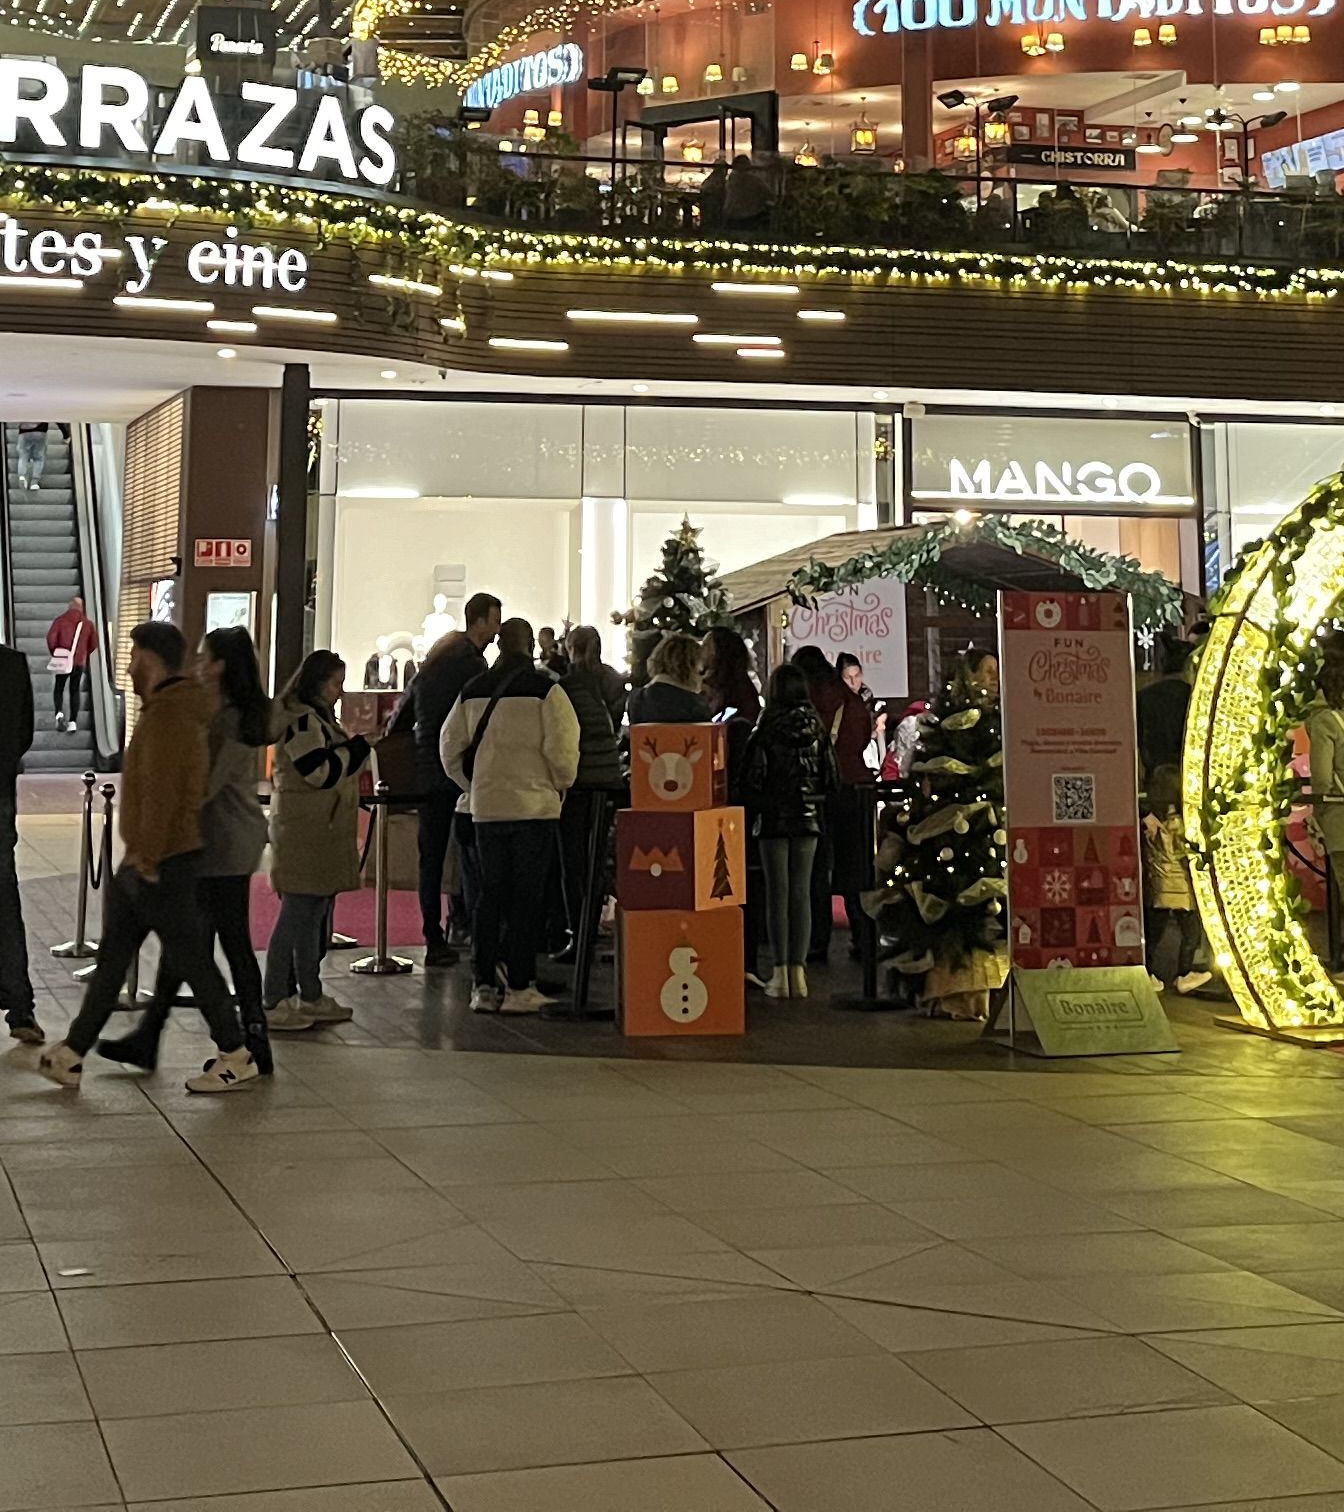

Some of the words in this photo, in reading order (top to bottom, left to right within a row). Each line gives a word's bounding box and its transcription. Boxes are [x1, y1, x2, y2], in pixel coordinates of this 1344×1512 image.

[123, 231, 168, 294] y
[186, 225, 310, 292] cine
[949, 458, 1162, 499] MANGO
[790, 592, 894, 643] Christmas
[1054, 637, 1084, 648] FUN
[1028, 646, 1111, 686] Christmas
[1045, 688, 1103, 704] Bonaire
[1058, 997, 1130, 1016] Bonaire
